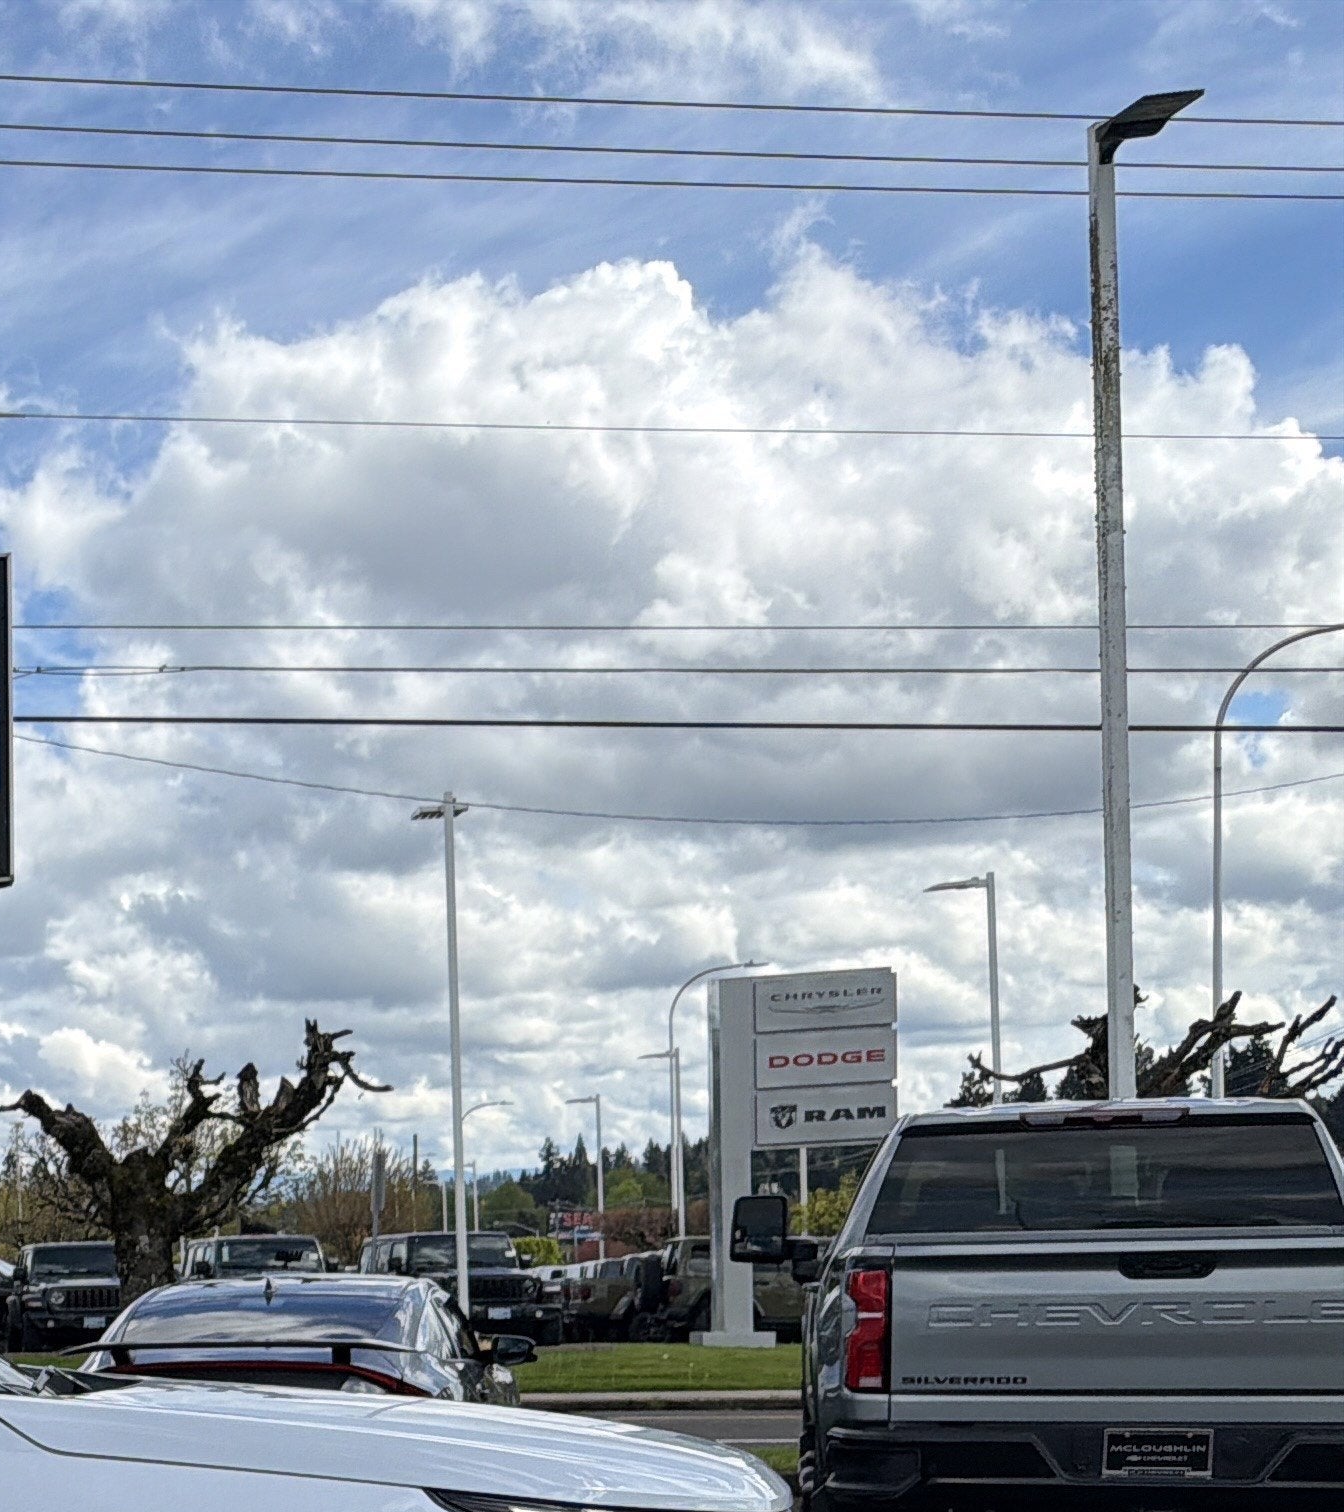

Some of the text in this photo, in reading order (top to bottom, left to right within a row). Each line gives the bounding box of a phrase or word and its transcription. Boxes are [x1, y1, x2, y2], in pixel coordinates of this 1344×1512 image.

[771, 987, 882, 1002] CHRYSLER
[768, 1049, 886, 1069] DODGE
[804, 1106, 886, 1122] RAM
[901, 1376, 1028, 1385] SILVERADO
